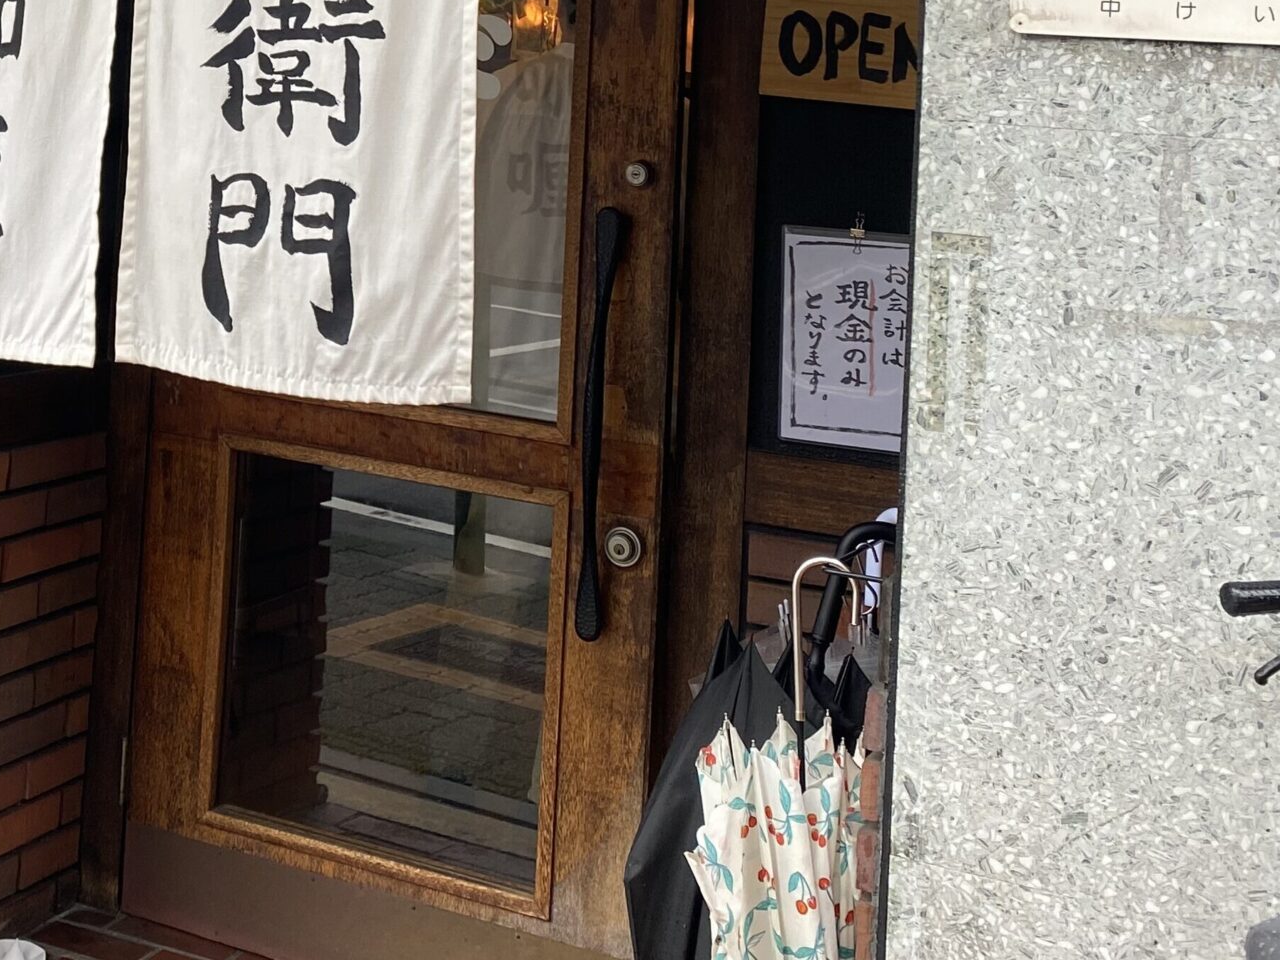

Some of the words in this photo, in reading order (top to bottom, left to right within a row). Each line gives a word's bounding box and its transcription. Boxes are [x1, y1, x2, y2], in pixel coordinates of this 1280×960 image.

[800, 290, 828, 401] となります。
[833, 280, 878, 388] 現金のみ
[878, 263, 908, 368] お会計は
